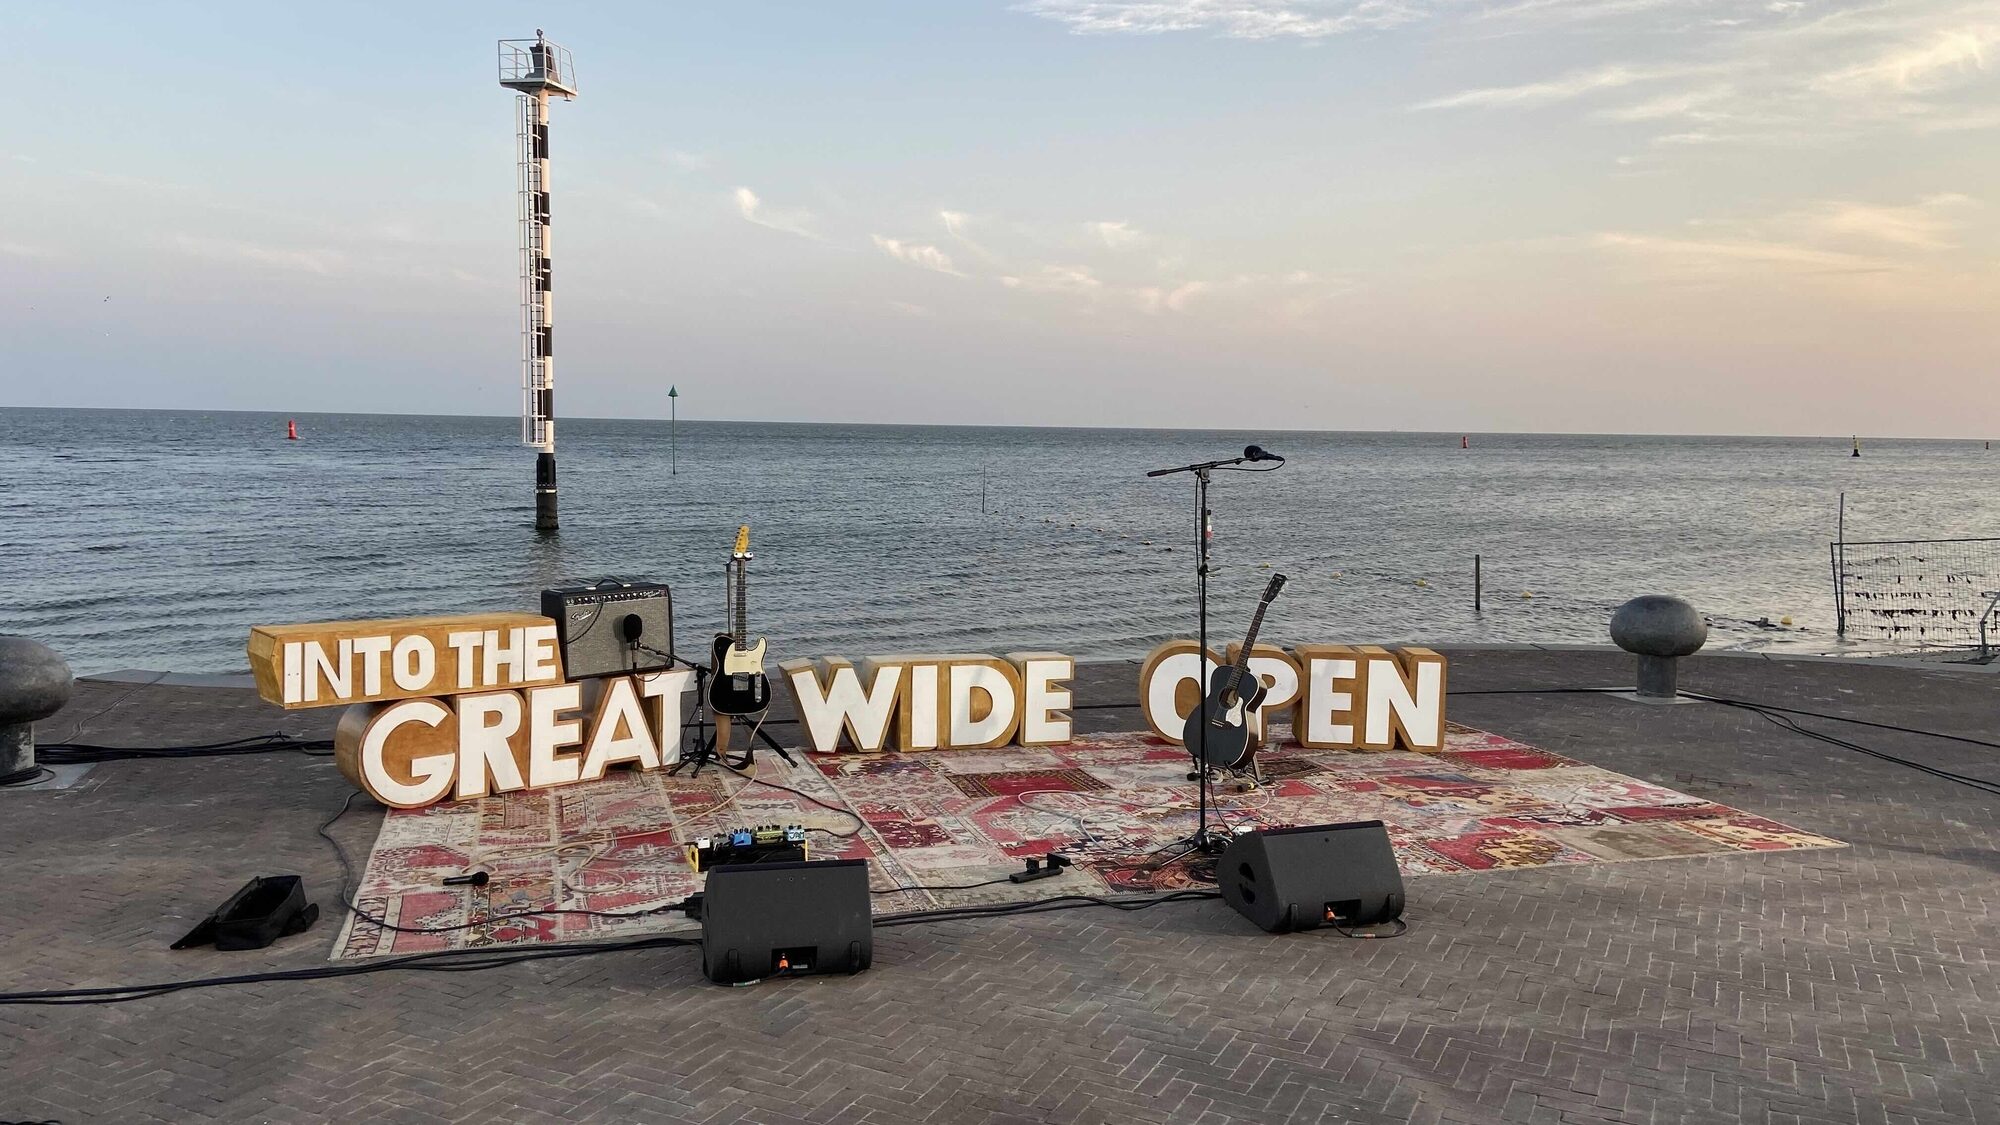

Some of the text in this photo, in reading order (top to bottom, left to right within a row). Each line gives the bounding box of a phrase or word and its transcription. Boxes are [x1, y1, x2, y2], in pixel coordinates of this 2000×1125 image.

[284, 627, 558, 703] INTO THE
[362, 653, 1442, 805] GREAT WIDE OPEN
